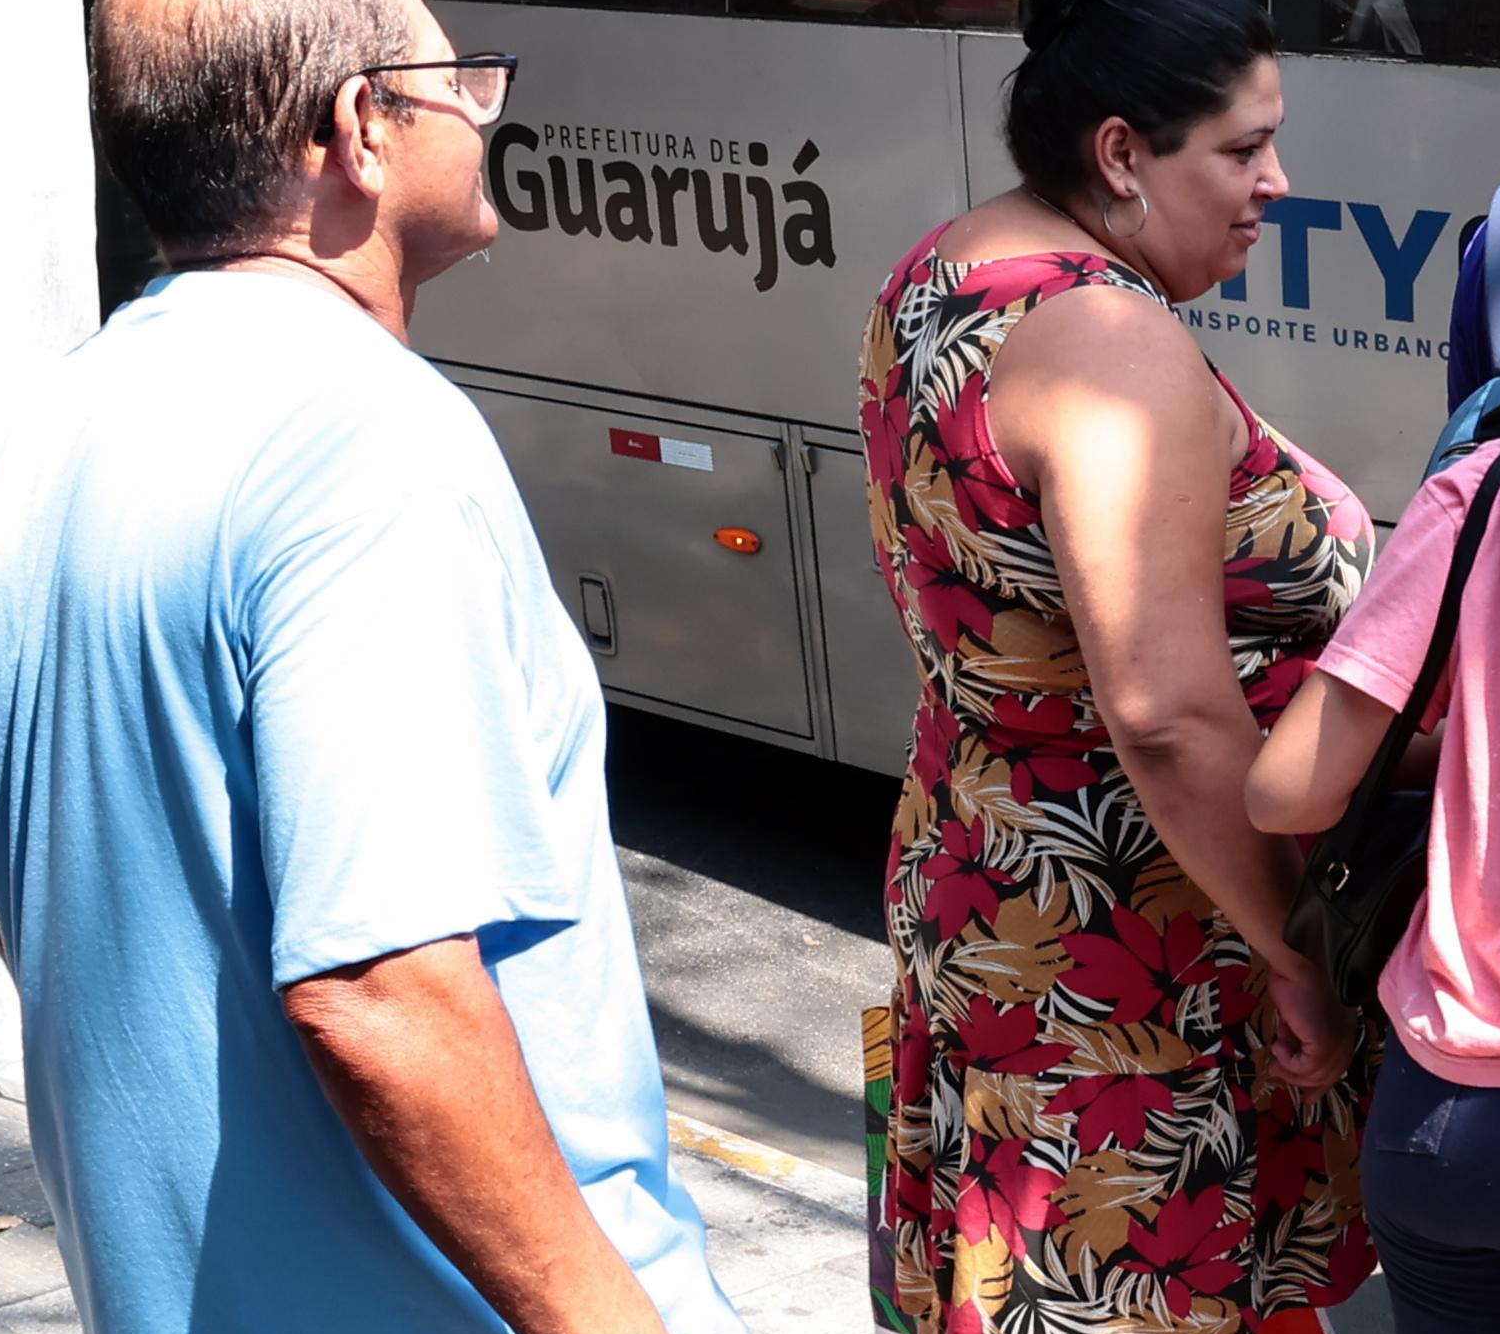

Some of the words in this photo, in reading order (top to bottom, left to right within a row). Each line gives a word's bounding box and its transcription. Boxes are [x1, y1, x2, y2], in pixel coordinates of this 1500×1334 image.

[543, 124, 696, 160] PREFEITURA
[710, 139, 741, 164] DE
[488, 121, 836, 293] Guarujá
[1220, 197, 1452, 323] TY
[1175, 307, 1317, 343] ANSPORTE
